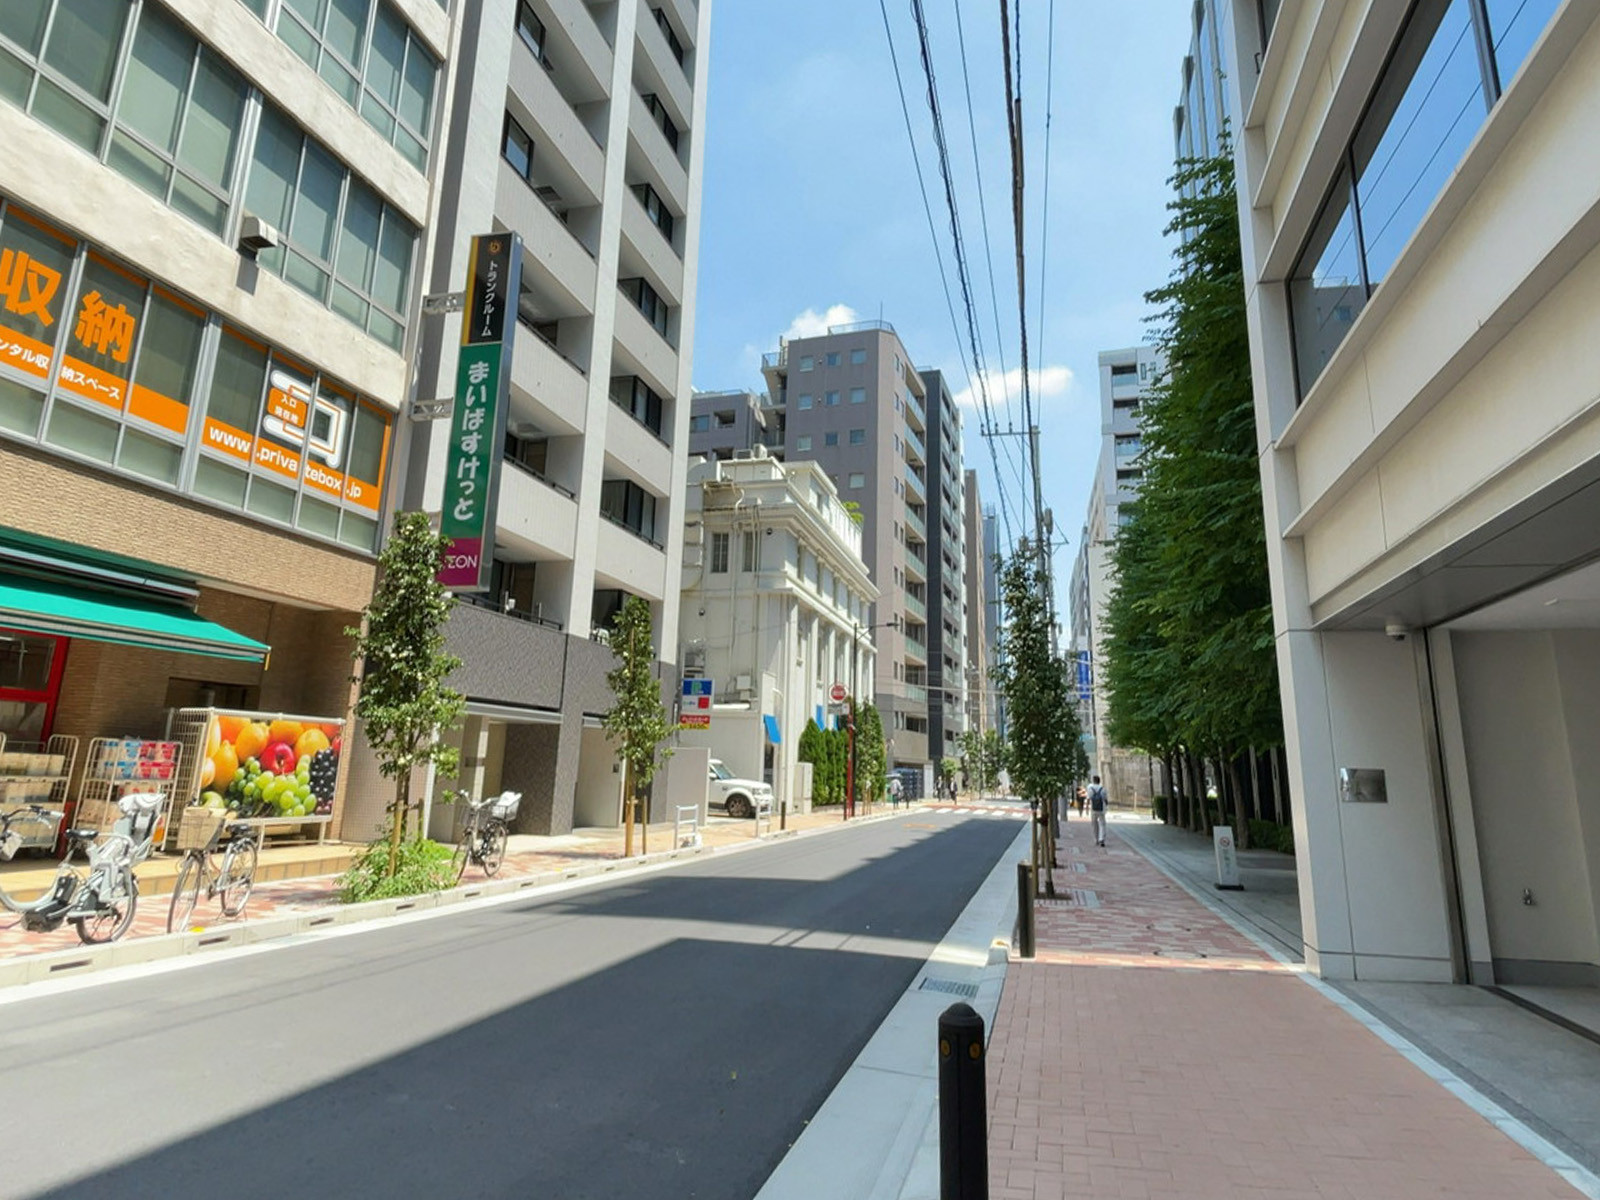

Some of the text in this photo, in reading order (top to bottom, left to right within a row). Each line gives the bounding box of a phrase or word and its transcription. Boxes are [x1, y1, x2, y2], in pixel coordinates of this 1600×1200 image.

[481, 260, 498, 337] トランクルーム
[454, 361, 490, 521] まいばすけっと
